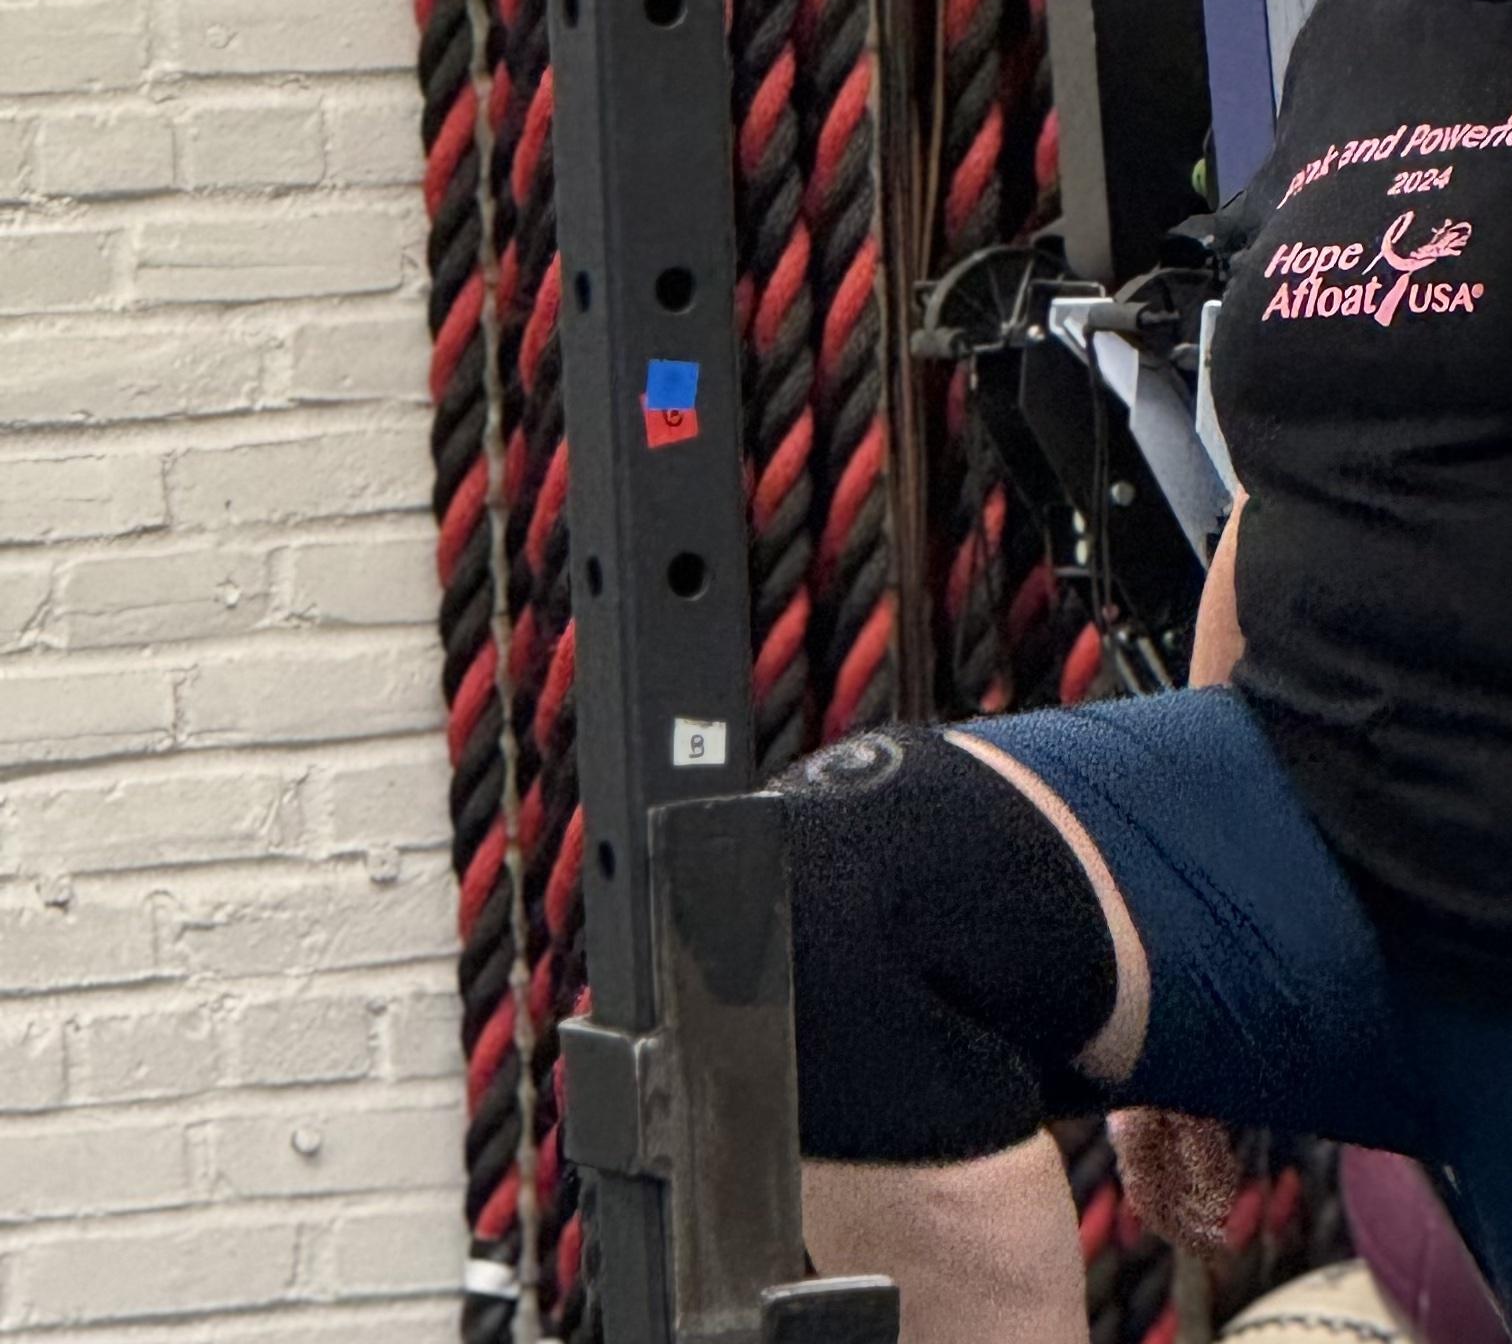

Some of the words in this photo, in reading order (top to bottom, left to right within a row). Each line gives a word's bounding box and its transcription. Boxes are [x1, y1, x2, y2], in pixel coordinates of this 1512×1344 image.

[1337, 125, 1408, 171] and
[1387, 166, 1453, 195] 2024
[1264, 242, 1364, 280] Hope
[1262, 276, 1382, 321] Afloat
